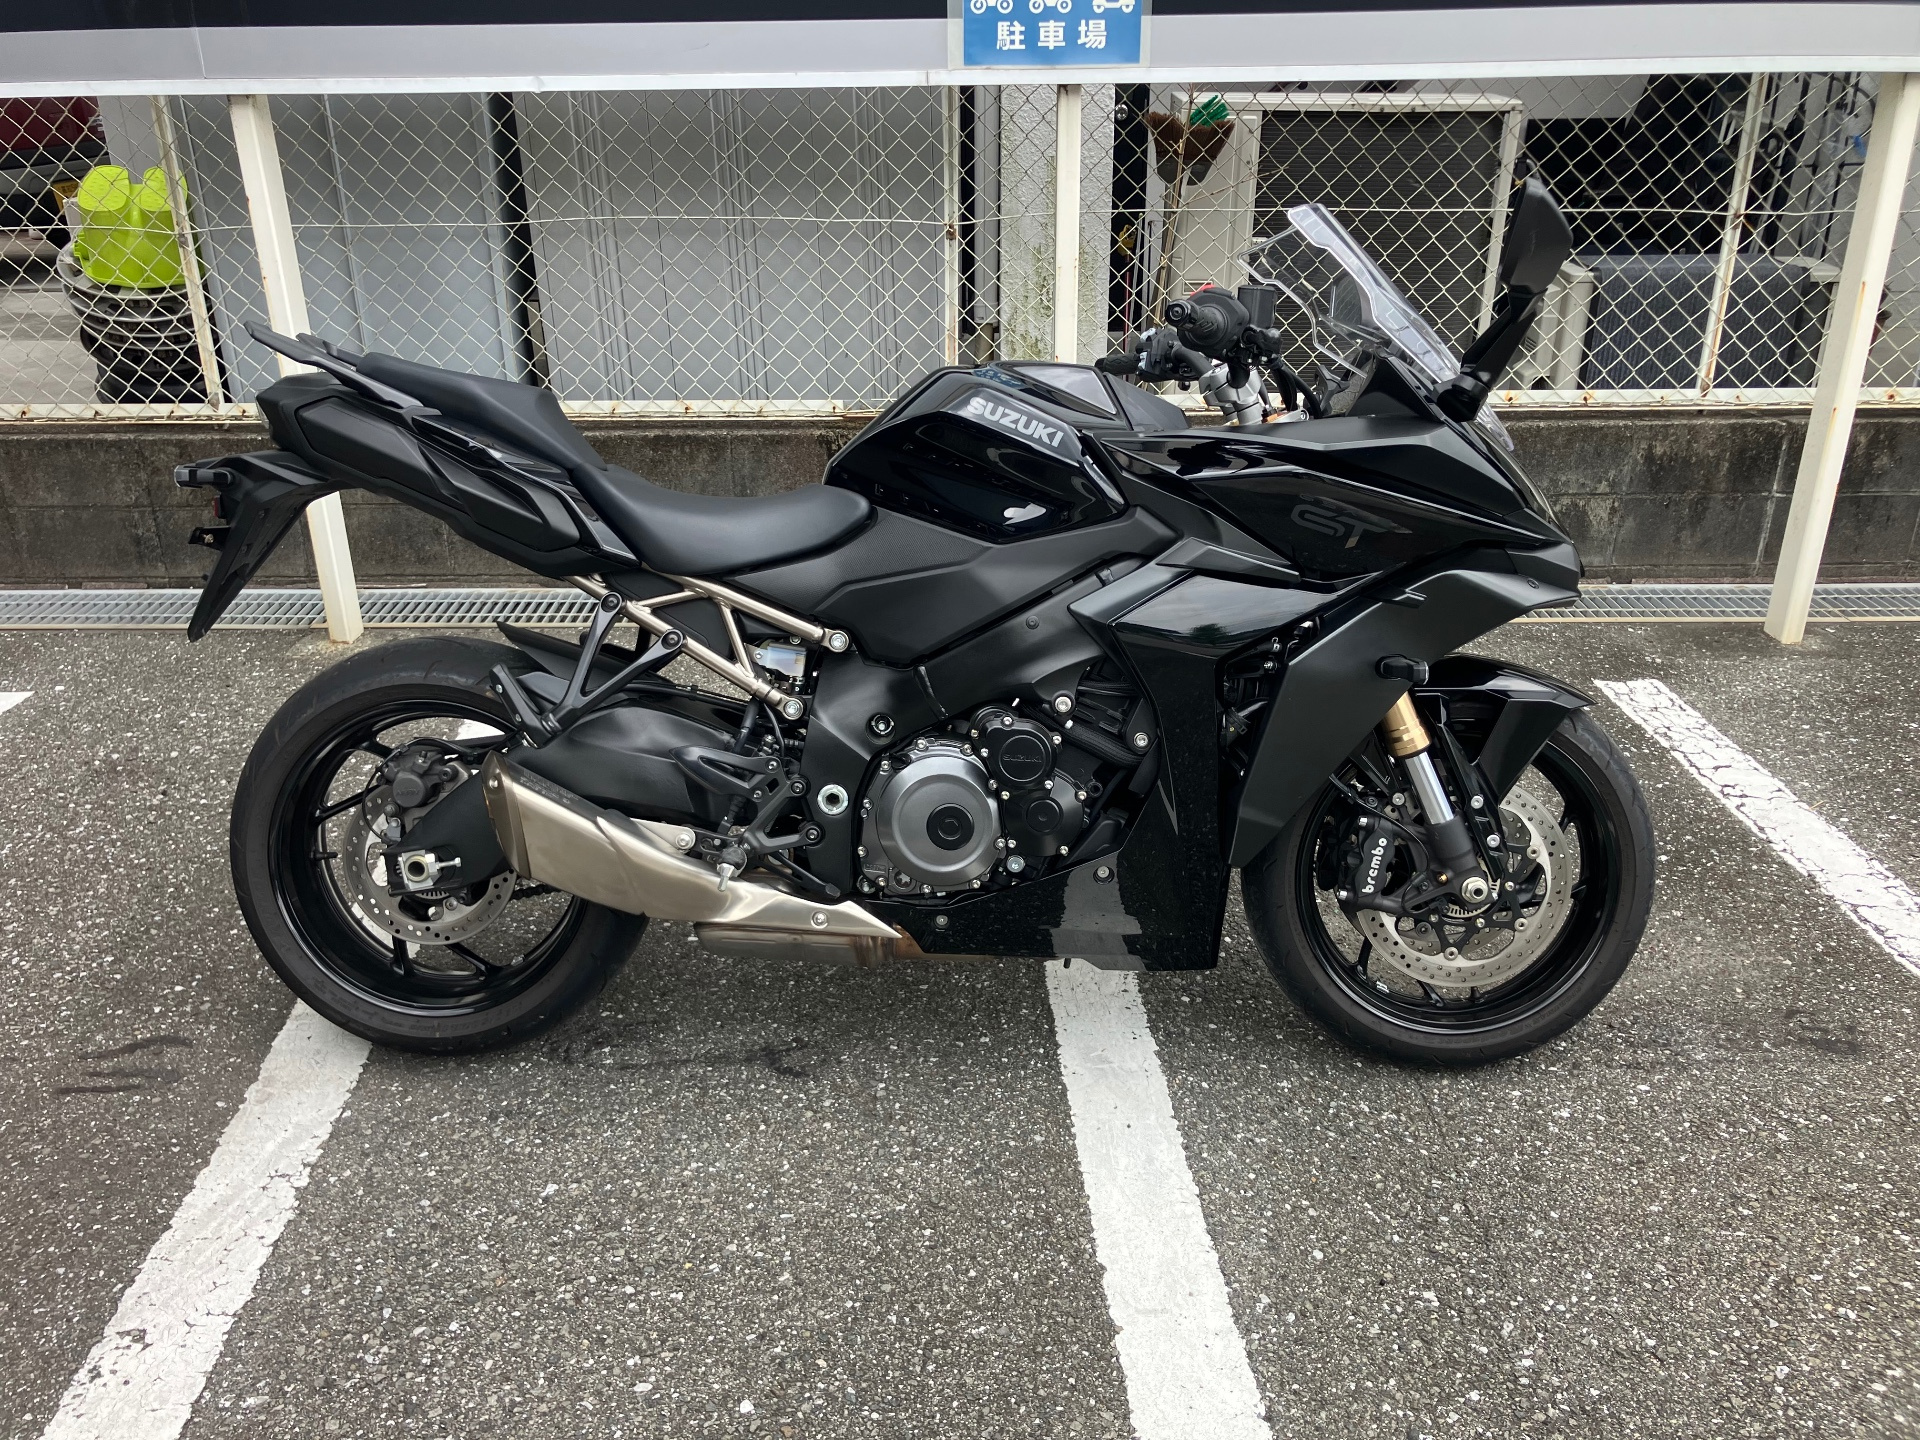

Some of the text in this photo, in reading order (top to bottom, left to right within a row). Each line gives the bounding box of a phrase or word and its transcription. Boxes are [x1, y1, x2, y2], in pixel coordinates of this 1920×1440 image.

[996, 19, 1107, 50] 駐車場
[966, 396, 1064, 448] SUZUKI
[1002, 753, 1042, 763] SUZUKI
[1361, 837, 1388, 894] brembo
